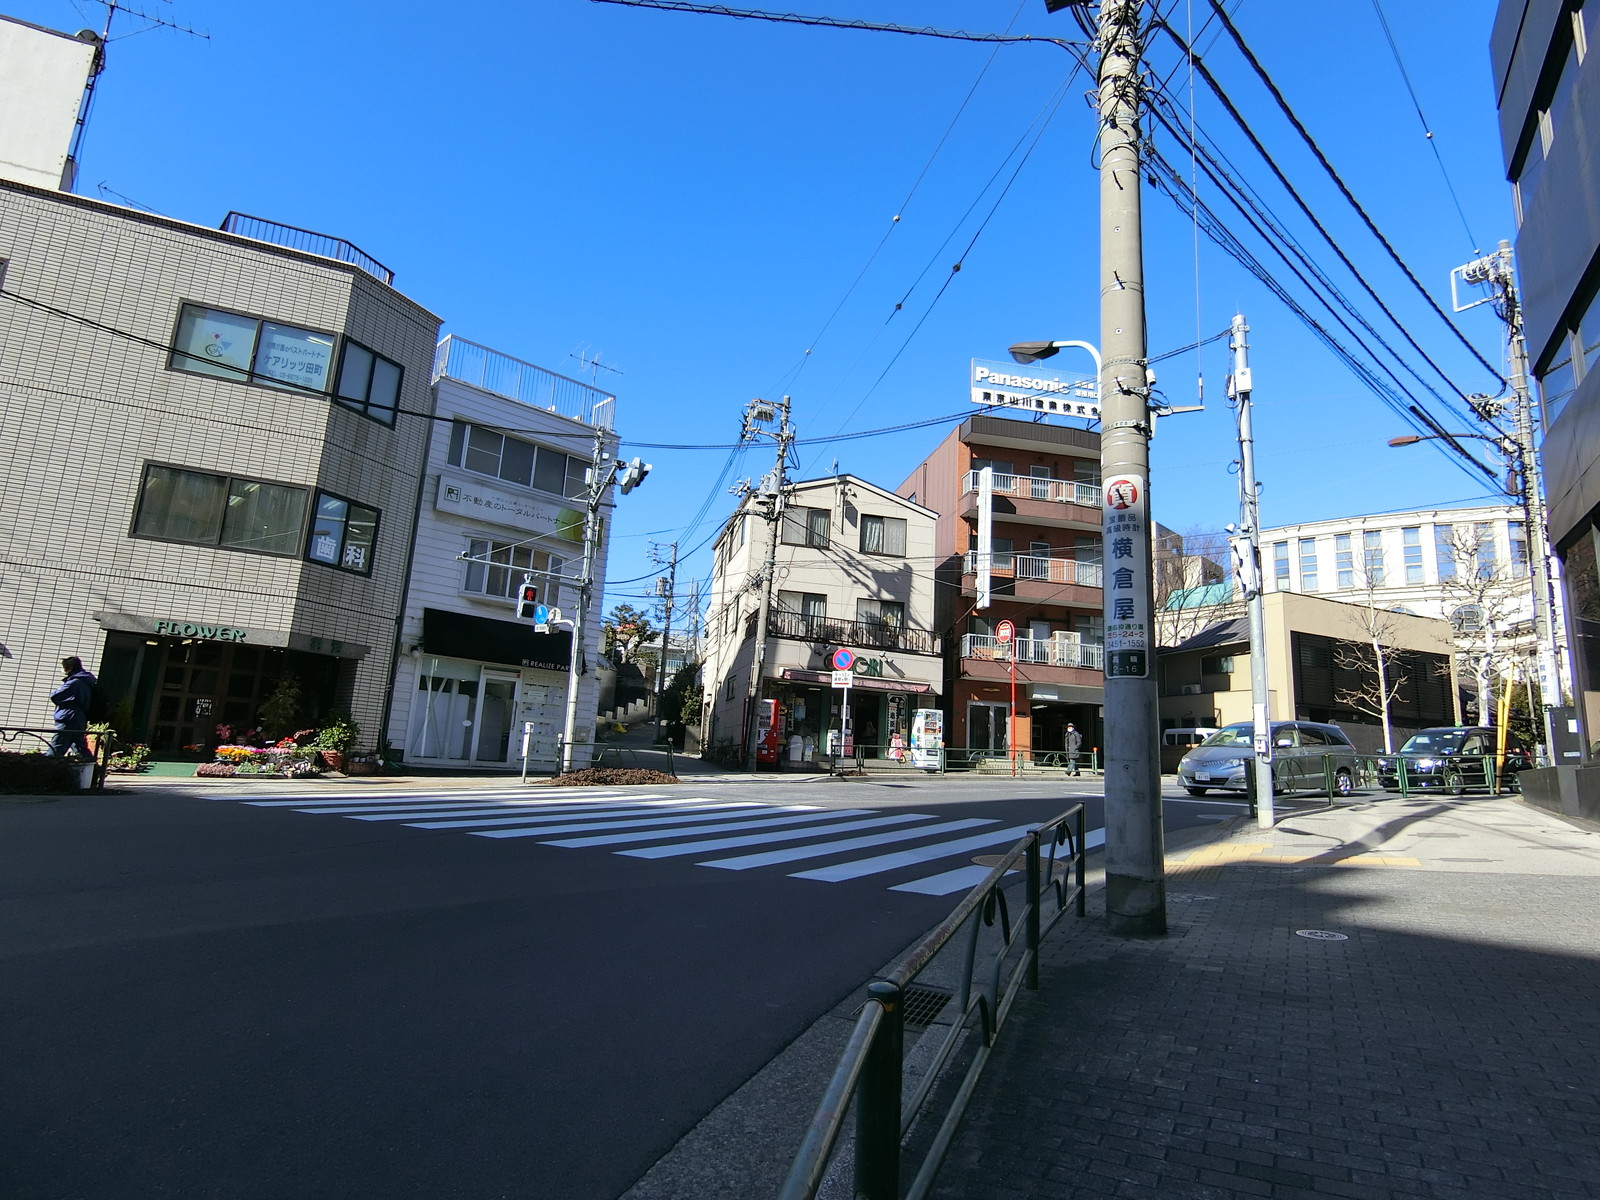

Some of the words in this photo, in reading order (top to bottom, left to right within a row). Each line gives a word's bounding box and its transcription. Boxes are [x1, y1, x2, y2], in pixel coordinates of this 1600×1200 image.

[264, 354, 322, 376] ケアリッツ田町
[975, 366, 1070, 394] Panasonic
[462, 493, 569, 526] 不動産のトータルパートナー
[1111, 536, 1135, 620] 横倉屋
[154, 620, 246, 643] FLOWER
[1107, 639, 1145, 649] 3451-1552
[530, 660, 555, 670] REALIZE
[1112, 665, 1138, 674] 2-16
